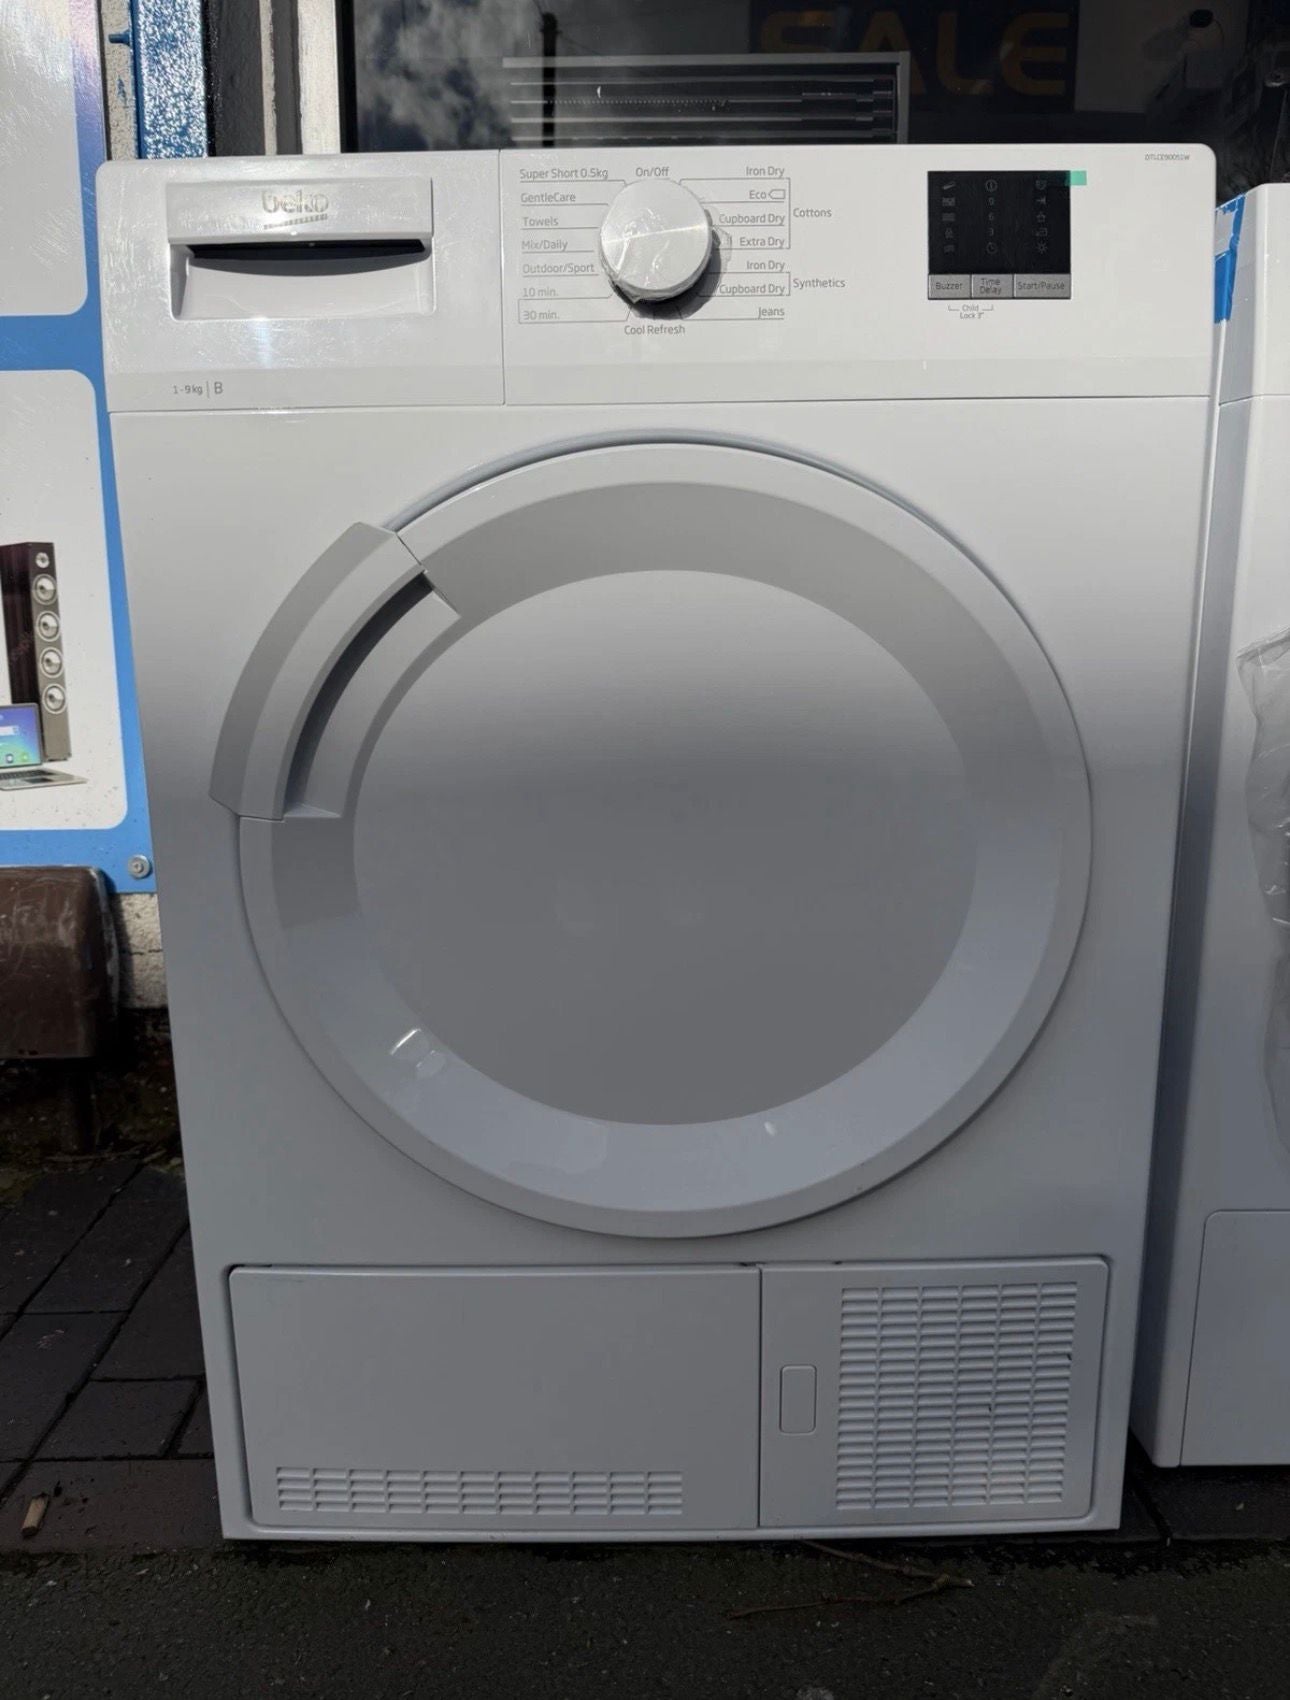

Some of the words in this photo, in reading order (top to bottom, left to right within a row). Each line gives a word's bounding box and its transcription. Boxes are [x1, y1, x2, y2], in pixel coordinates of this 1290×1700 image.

[520, 168, 549, 180] Super
[552, 168, 578, 178] Short
[580, 168, 608, 179] 0.5kg
[636, 167, 670, 177] On/Off
[746, 167, 765, 176] Iron
[768, 167, 785, 178] Dry
[521, 193, 576, 202] GentleCare
[749, 190, 767, 199] Eco
[793, 208, 832, 217] Cottons
[523, 216, 559, 226] Towels
[719, 214, 766, 224] Cupboard
[768, 214, 785, 225] Dry
[522, 240, 568, 251] Mix/Daily
[740, 237, 765, 246] Extra
[768, 238, 785, 248] Dry
[523, 263, 594, 275] Outdoor/Sport
[747, 261, 766, 269] Iron
[768, 261, 785, 272] Dry
[793, 278, 845, 289] Synthetics
[936, 282, 963, 290] Buzzer
[981, 278, 1001, 286] Time
[1018, 282, 1065, 290] Start/Pause
[523, 288, 536, 297] 10
[538, 288, 558, 297] min.
[719, 284, 766, 294] Cupboard
[768, 285, 785, 294] Dry
[980, 286, 1002, 295] Delay
[523, 311, 537, 320] 30
[538, 311, 559, 320] min.
[758, 307, 785, 317] Jeans
[625, 325, 645, 334] Cool
[647, 325, 685, 335] Refresh
[214, 383, 223, 394] B
